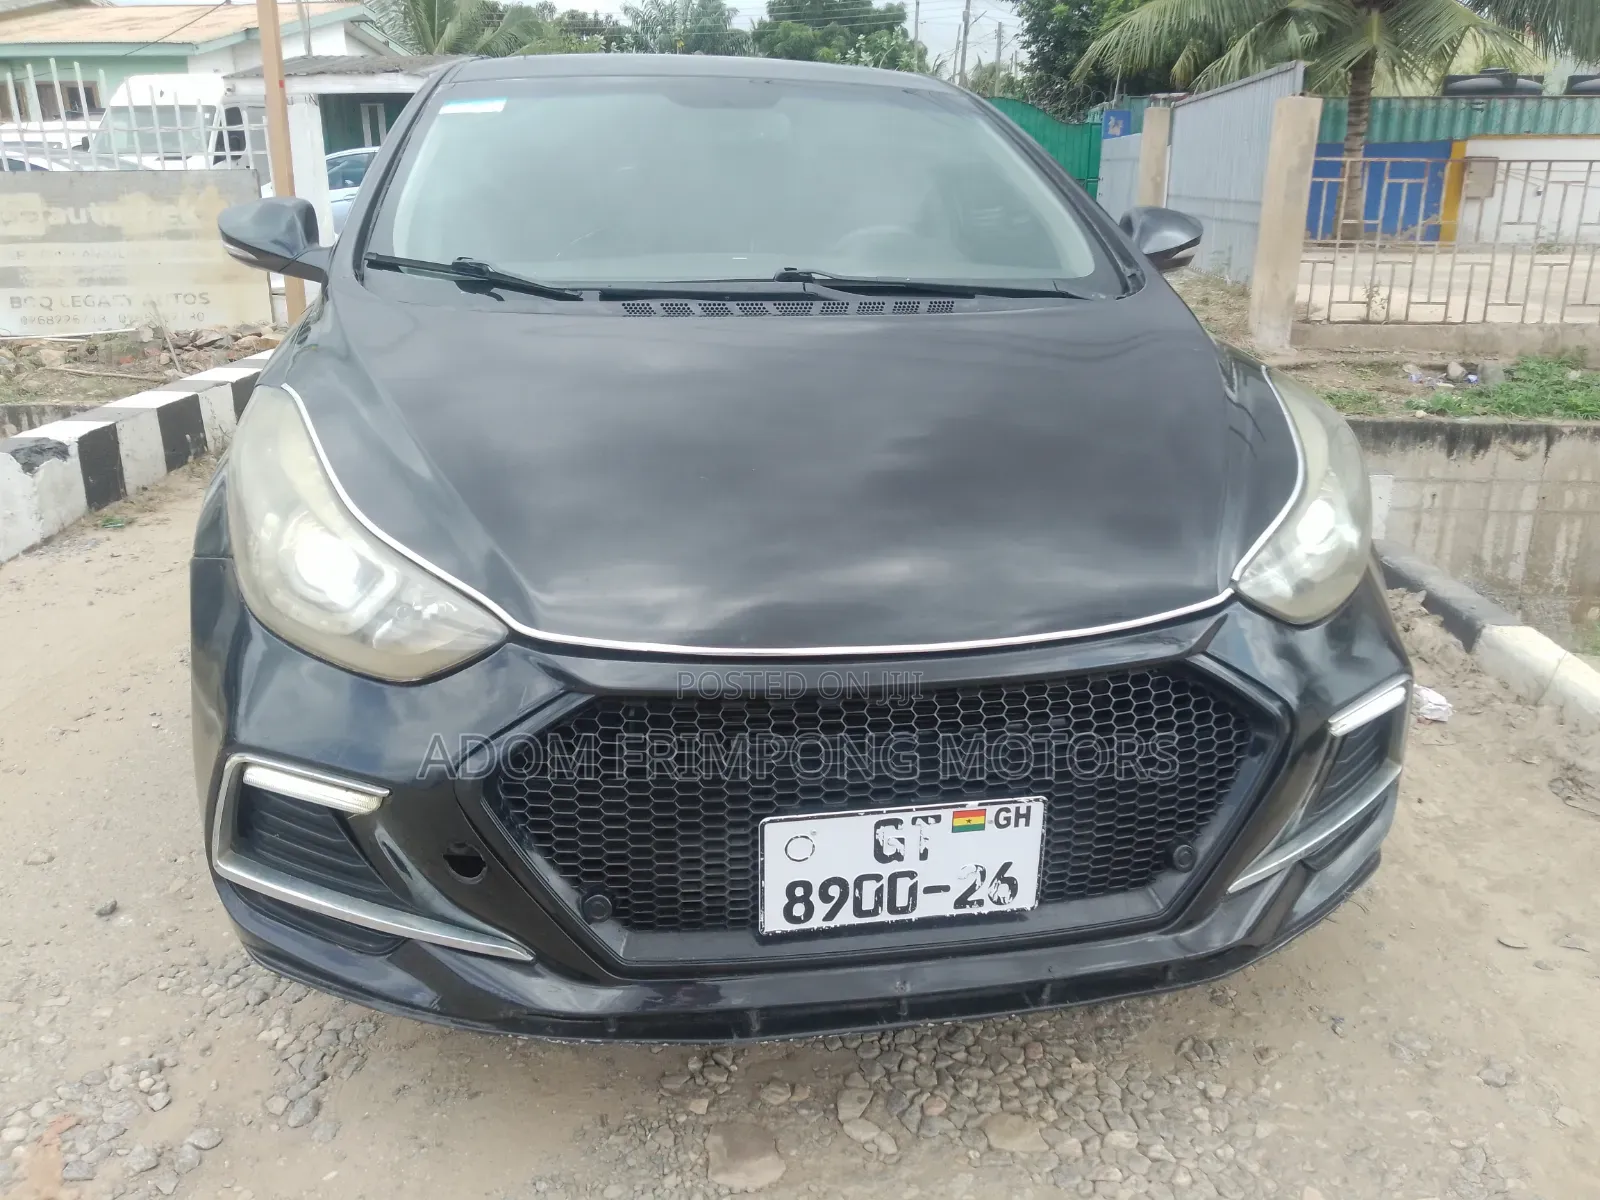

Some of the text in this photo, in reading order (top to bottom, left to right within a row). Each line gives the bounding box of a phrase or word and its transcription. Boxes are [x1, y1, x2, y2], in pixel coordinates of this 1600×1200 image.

[873, 805, 1032, 865] GT GH
[782, 861, 1019, 925] 8900-26
